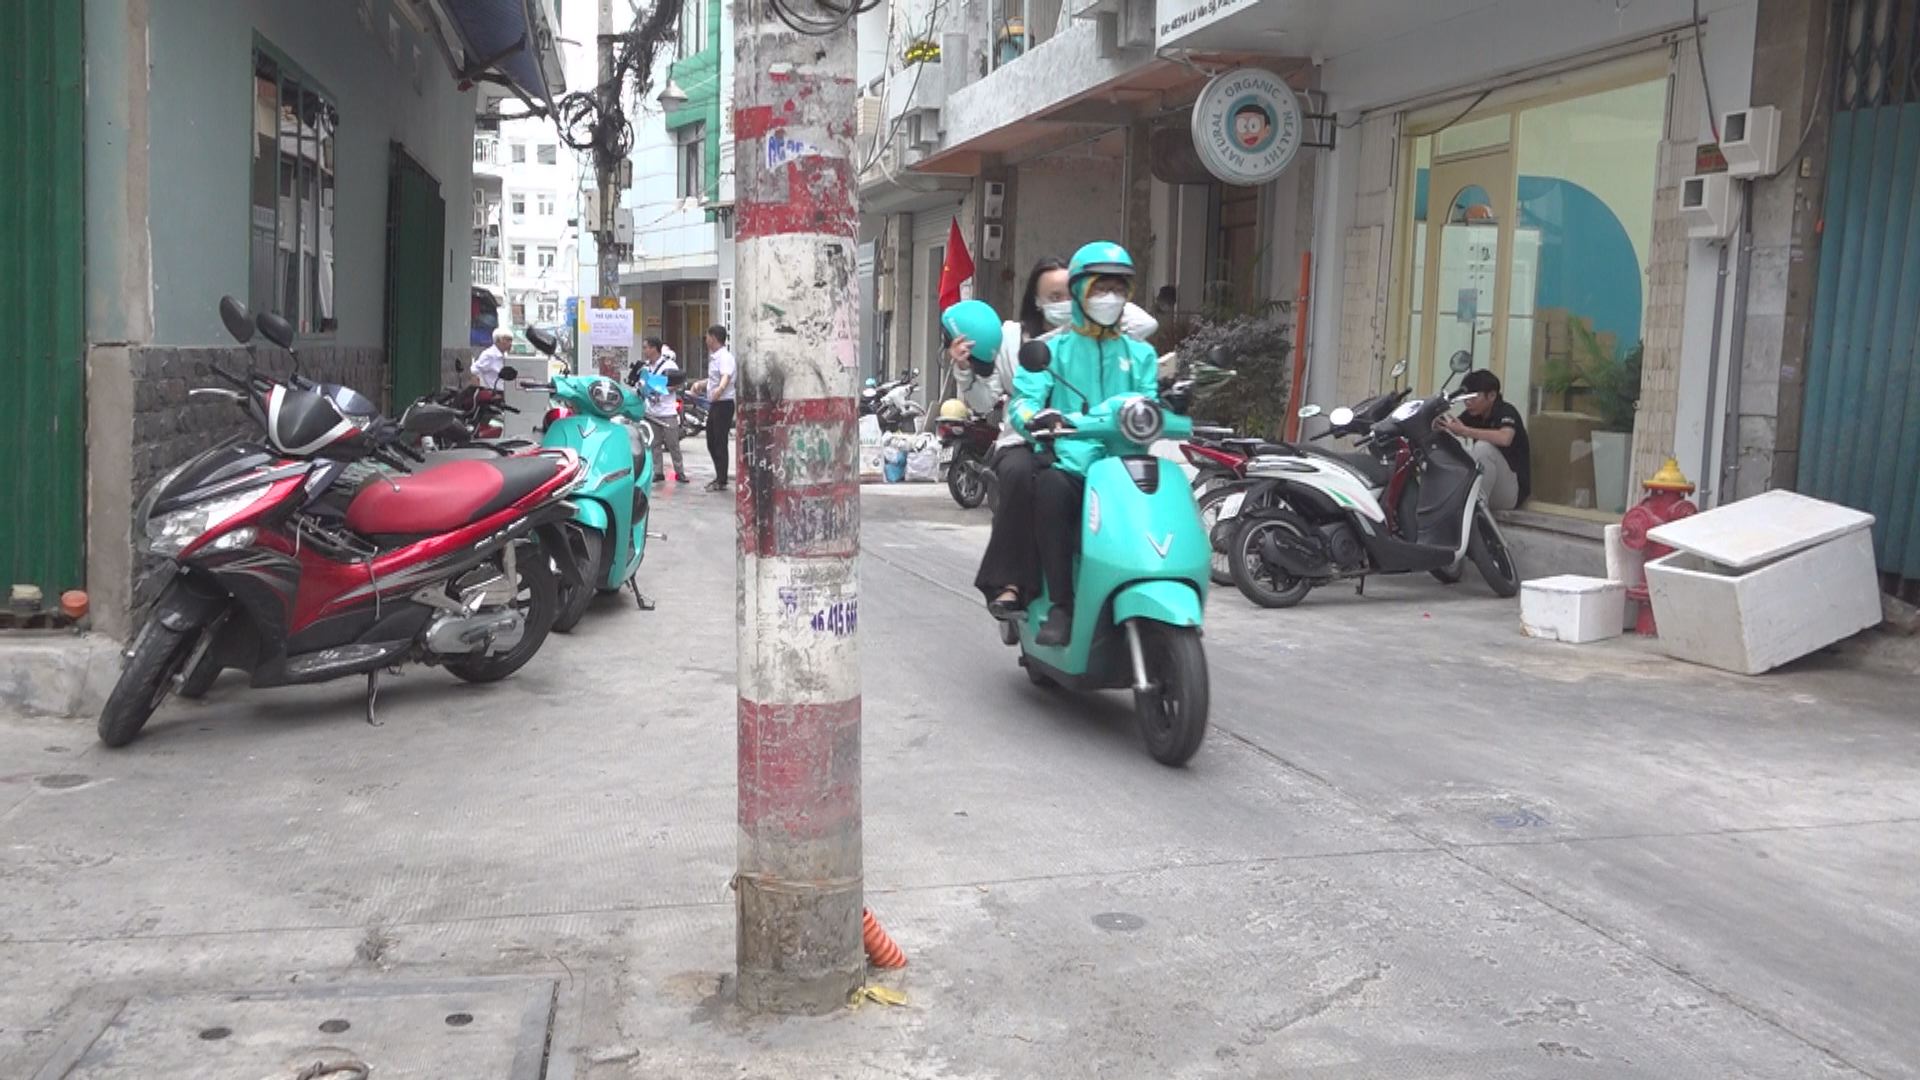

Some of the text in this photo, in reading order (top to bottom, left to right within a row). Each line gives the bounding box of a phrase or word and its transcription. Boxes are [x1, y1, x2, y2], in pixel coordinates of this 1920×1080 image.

[1225, 78, 1281, 99] ORGANIC
[1212, 112, 1245, 167] NATURAL
[1263, 110, 1294, 167] HEALTHY
